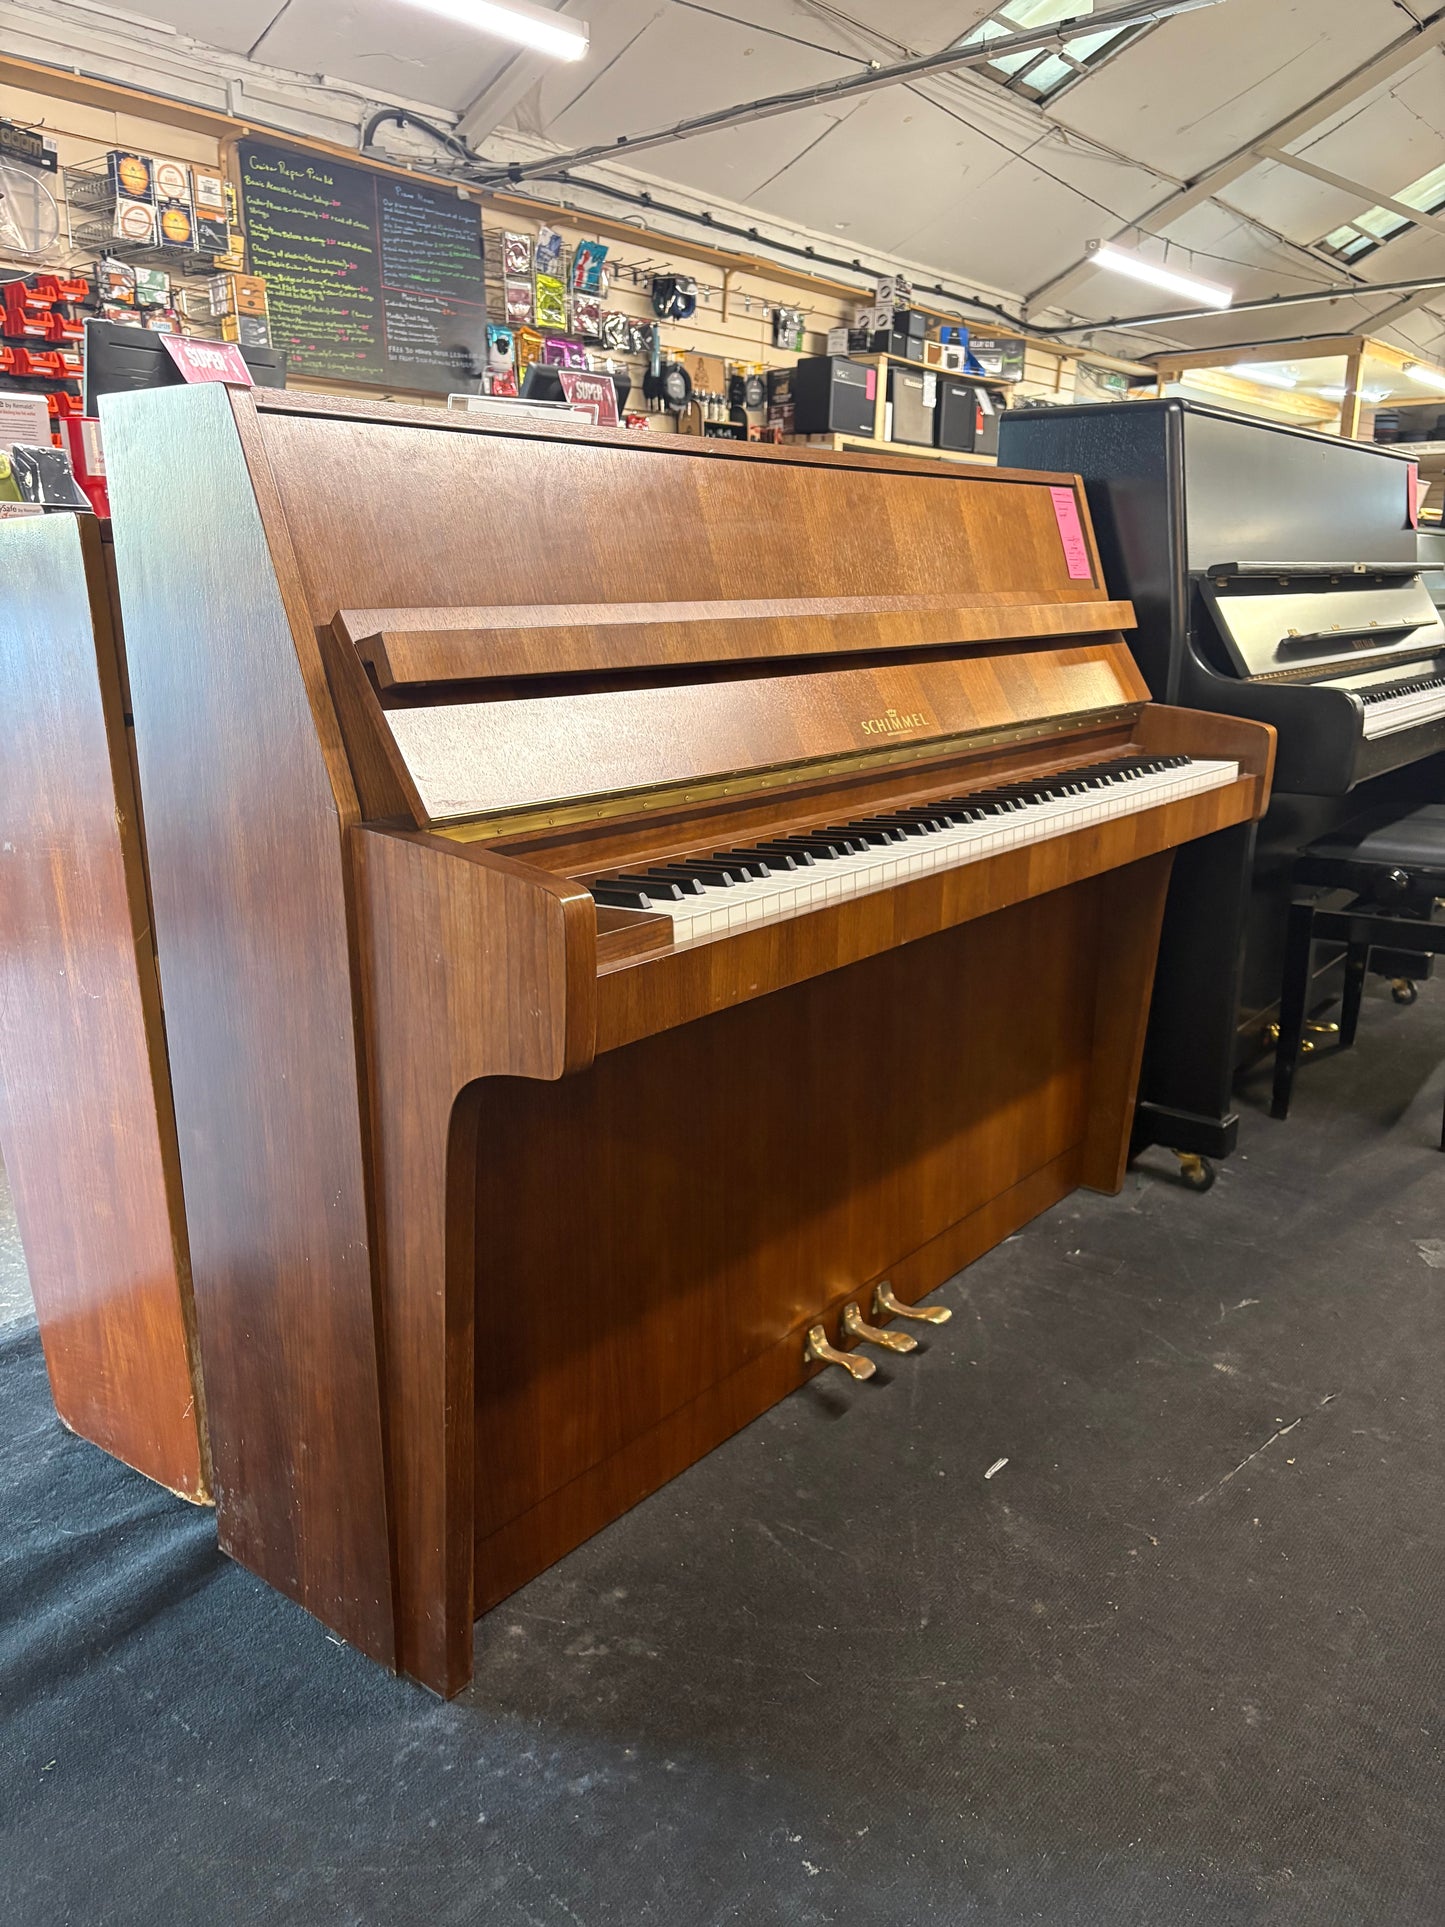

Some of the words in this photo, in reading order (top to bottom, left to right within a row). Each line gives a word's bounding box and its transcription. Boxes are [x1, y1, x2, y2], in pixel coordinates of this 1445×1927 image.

[184, 346, 228, 372] SUPER
[575, 381, 603, 401] SUPER
[860, 712, 930, 735] SCHIMMEL
